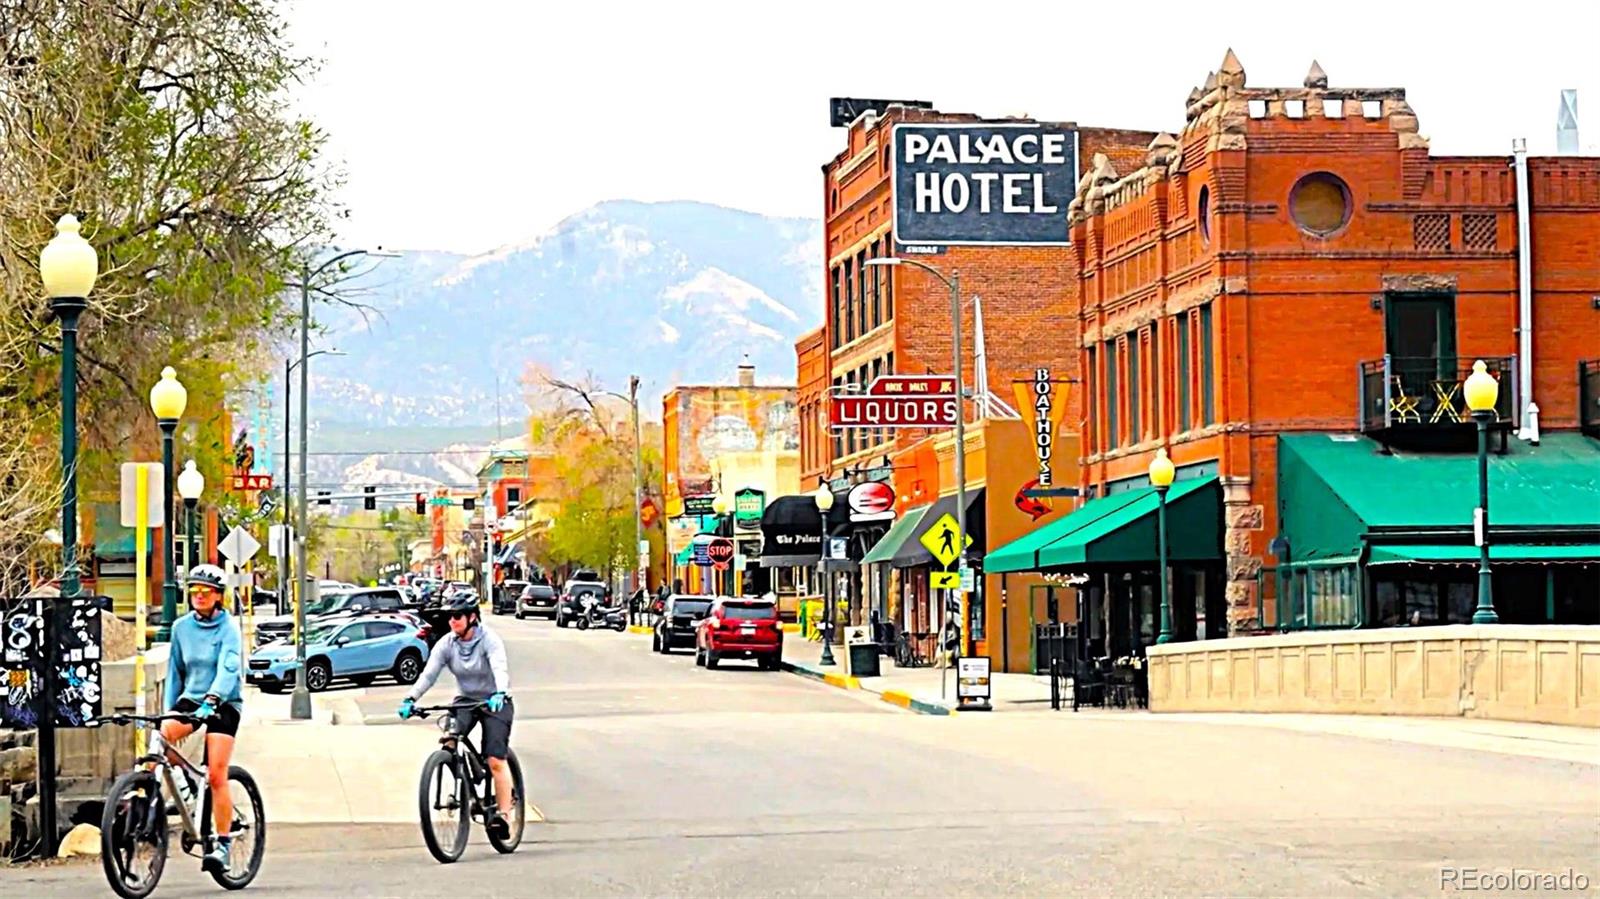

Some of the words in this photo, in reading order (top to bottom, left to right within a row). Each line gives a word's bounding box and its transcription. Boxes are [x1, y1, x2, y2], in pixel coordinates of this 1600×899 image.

[915, 172, 1058, 213] HOTEL
[840, 401, 957, 424] LIQUORS
[1035, 368, 1051, 486] BOATHOUSE
[234, 478, 270, 489] BAR
[709, 545, 733, 556] STOP
